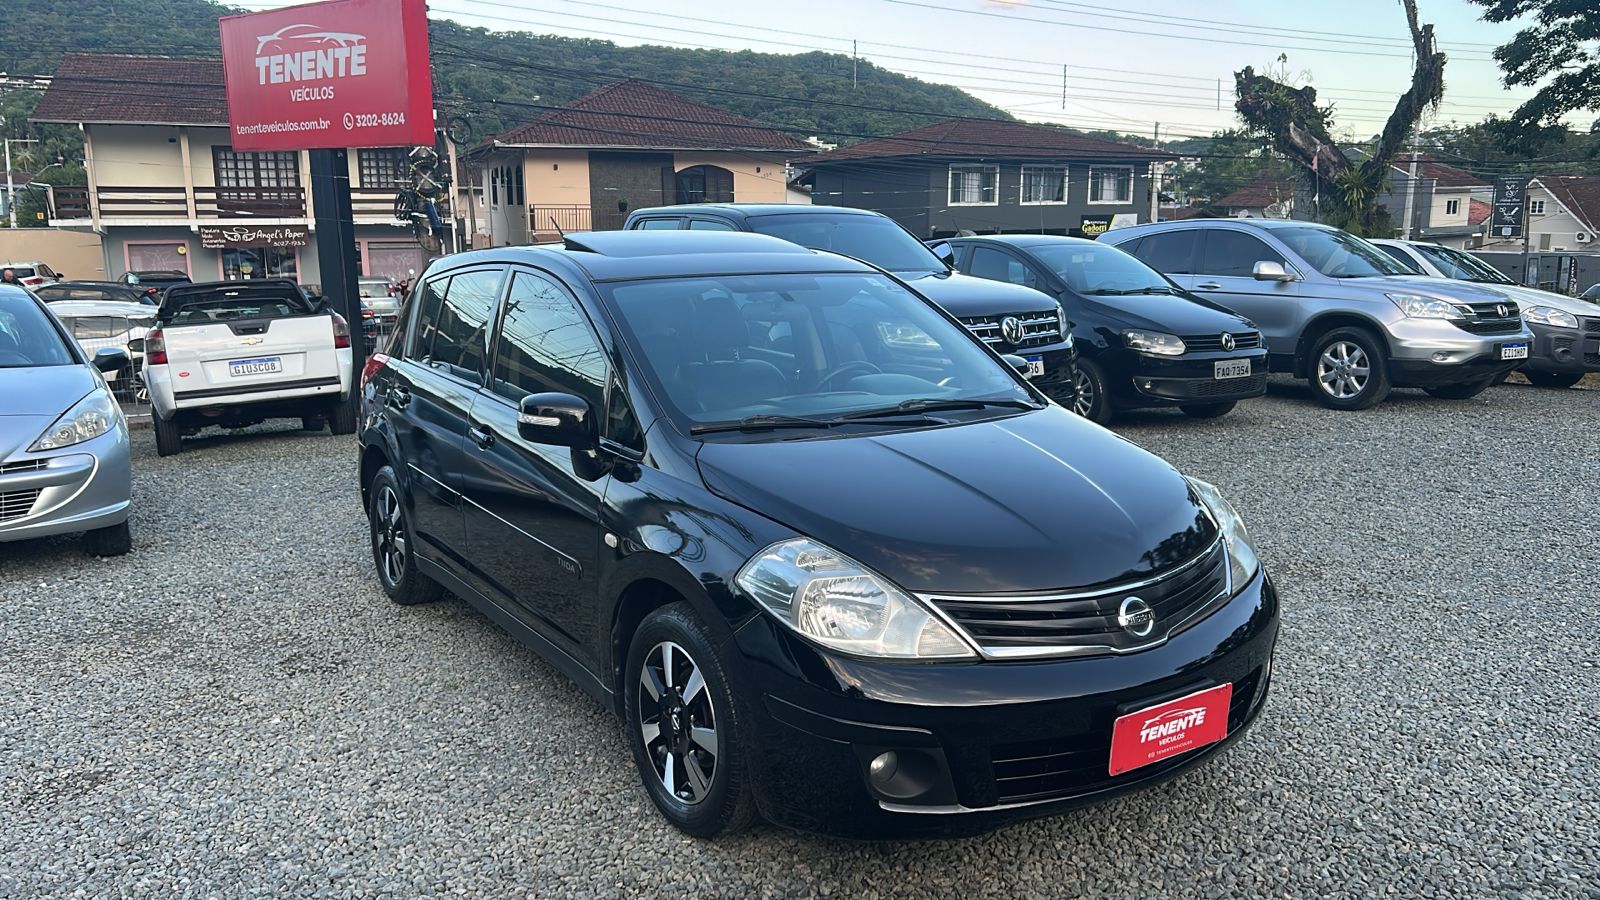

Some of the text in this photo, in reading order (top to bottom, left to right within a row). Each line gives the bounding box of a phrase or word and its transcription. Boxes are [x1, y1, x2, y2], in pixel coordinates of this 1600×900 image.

[255, 44, 367, 85] TENENTE
[290, 85, 335, 102] VEÍCULOS
[236, 112, 406, 135] tenenteveiculos.com.br 3202-8624
[256, 229, 305, 243] Angel's Paper
[1140, 711, 1207, 744] TENENTE
